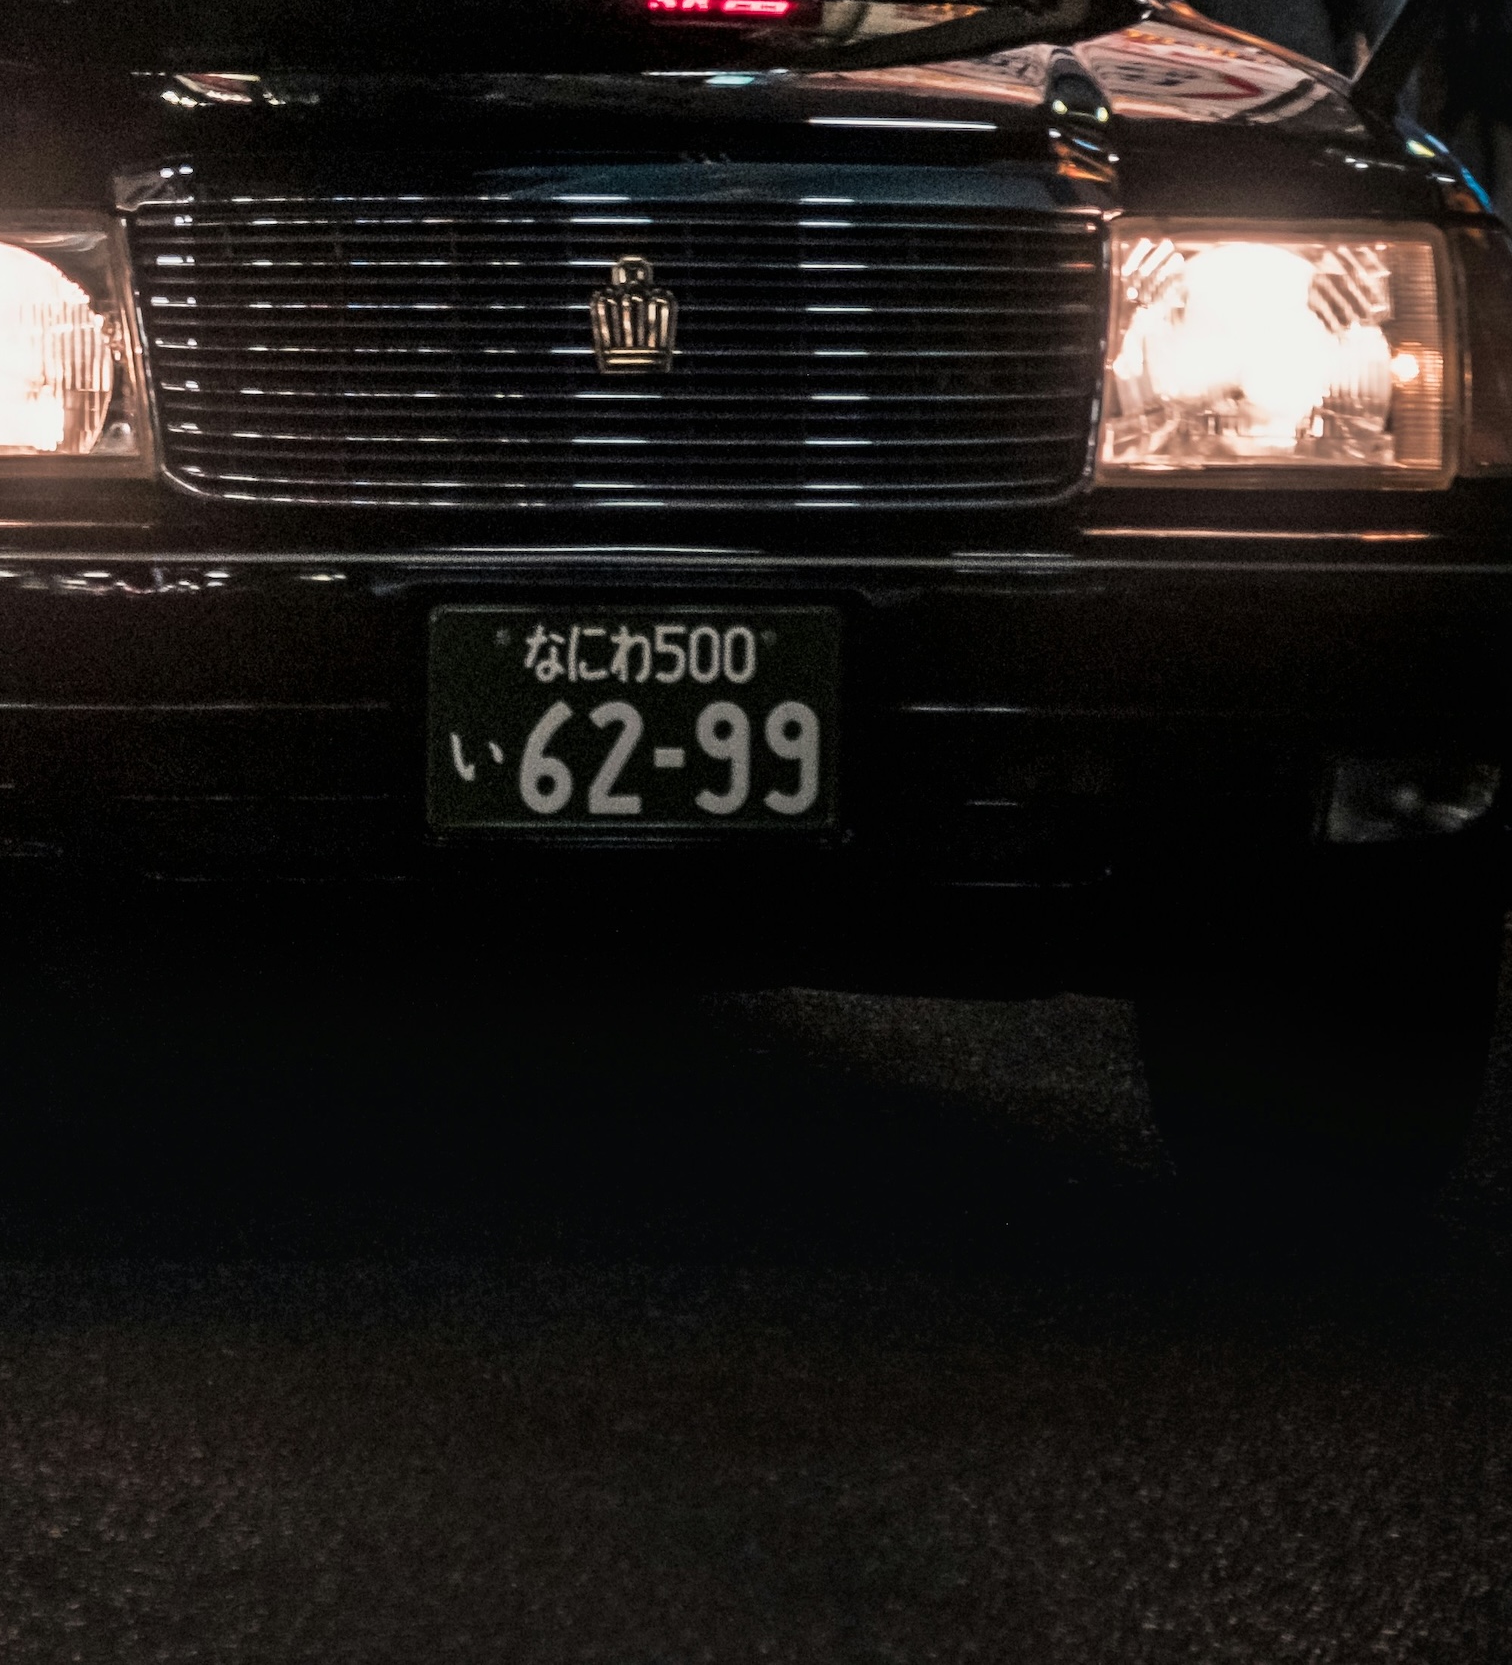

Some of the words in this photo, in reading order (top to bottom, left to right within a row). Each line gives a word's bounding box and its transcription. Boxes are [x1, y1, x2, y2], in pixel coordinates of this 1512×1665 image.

[524, 624, 757, 684] なにわ500
[451, 732, 505, 781] い
[519, 700, 820, 815] 62-99
